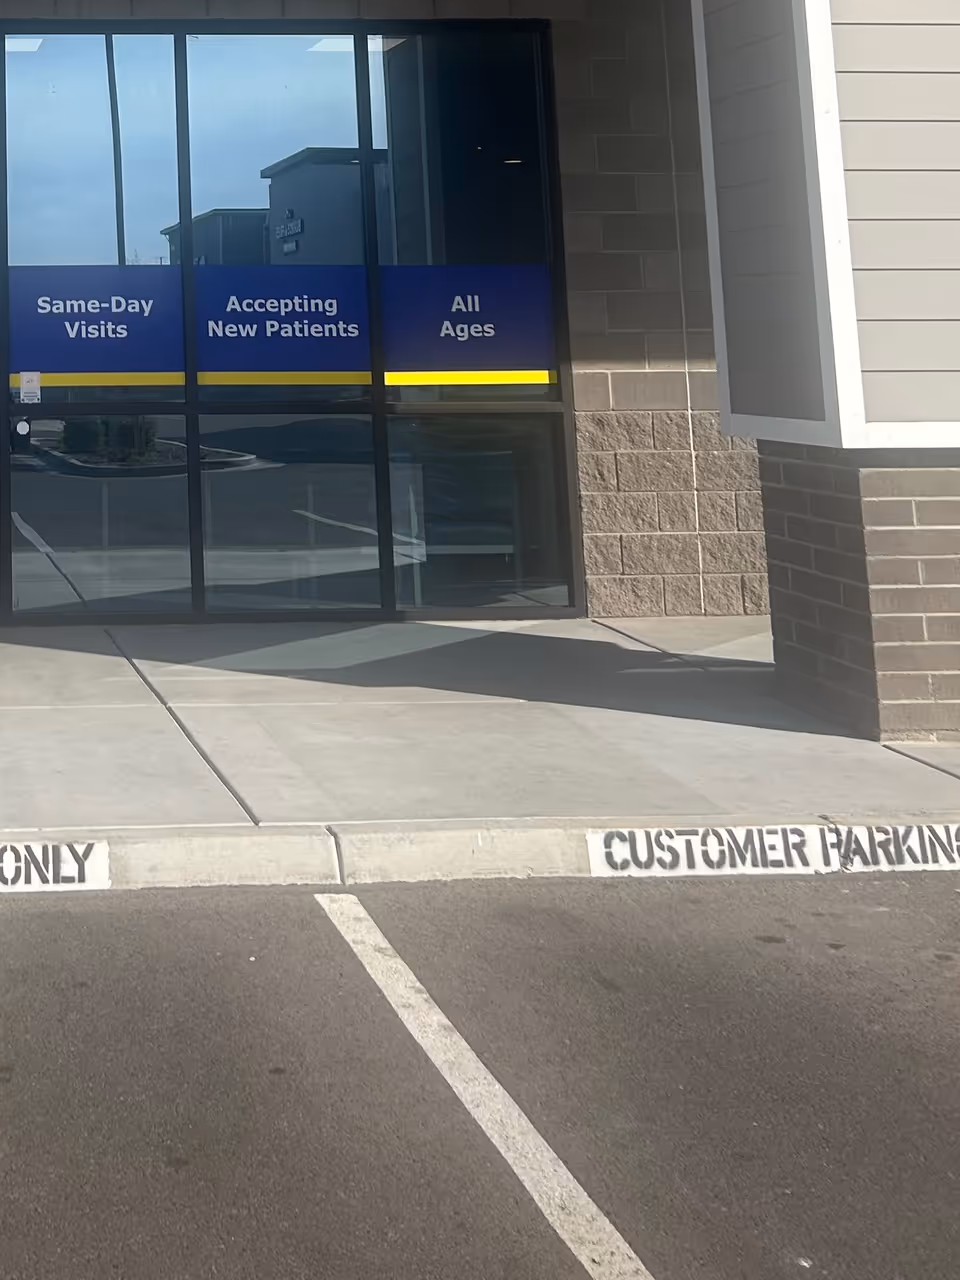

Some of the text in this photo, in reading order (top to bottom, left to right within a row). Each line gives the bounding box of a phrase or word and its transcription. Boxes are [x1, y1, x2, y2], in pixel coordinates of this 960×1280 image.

[36, 296, 153, 317] Same-Day
[225, 295, 338, 316] Accepting
[451, 295, 480, 312] All
[64, 321, 128, 339] Visits
[207, 320, 360, 338] New Patients
[440, 320, 496, 341] Ages
[603, 825, 960, 871] CUSTOMER PARKIN
